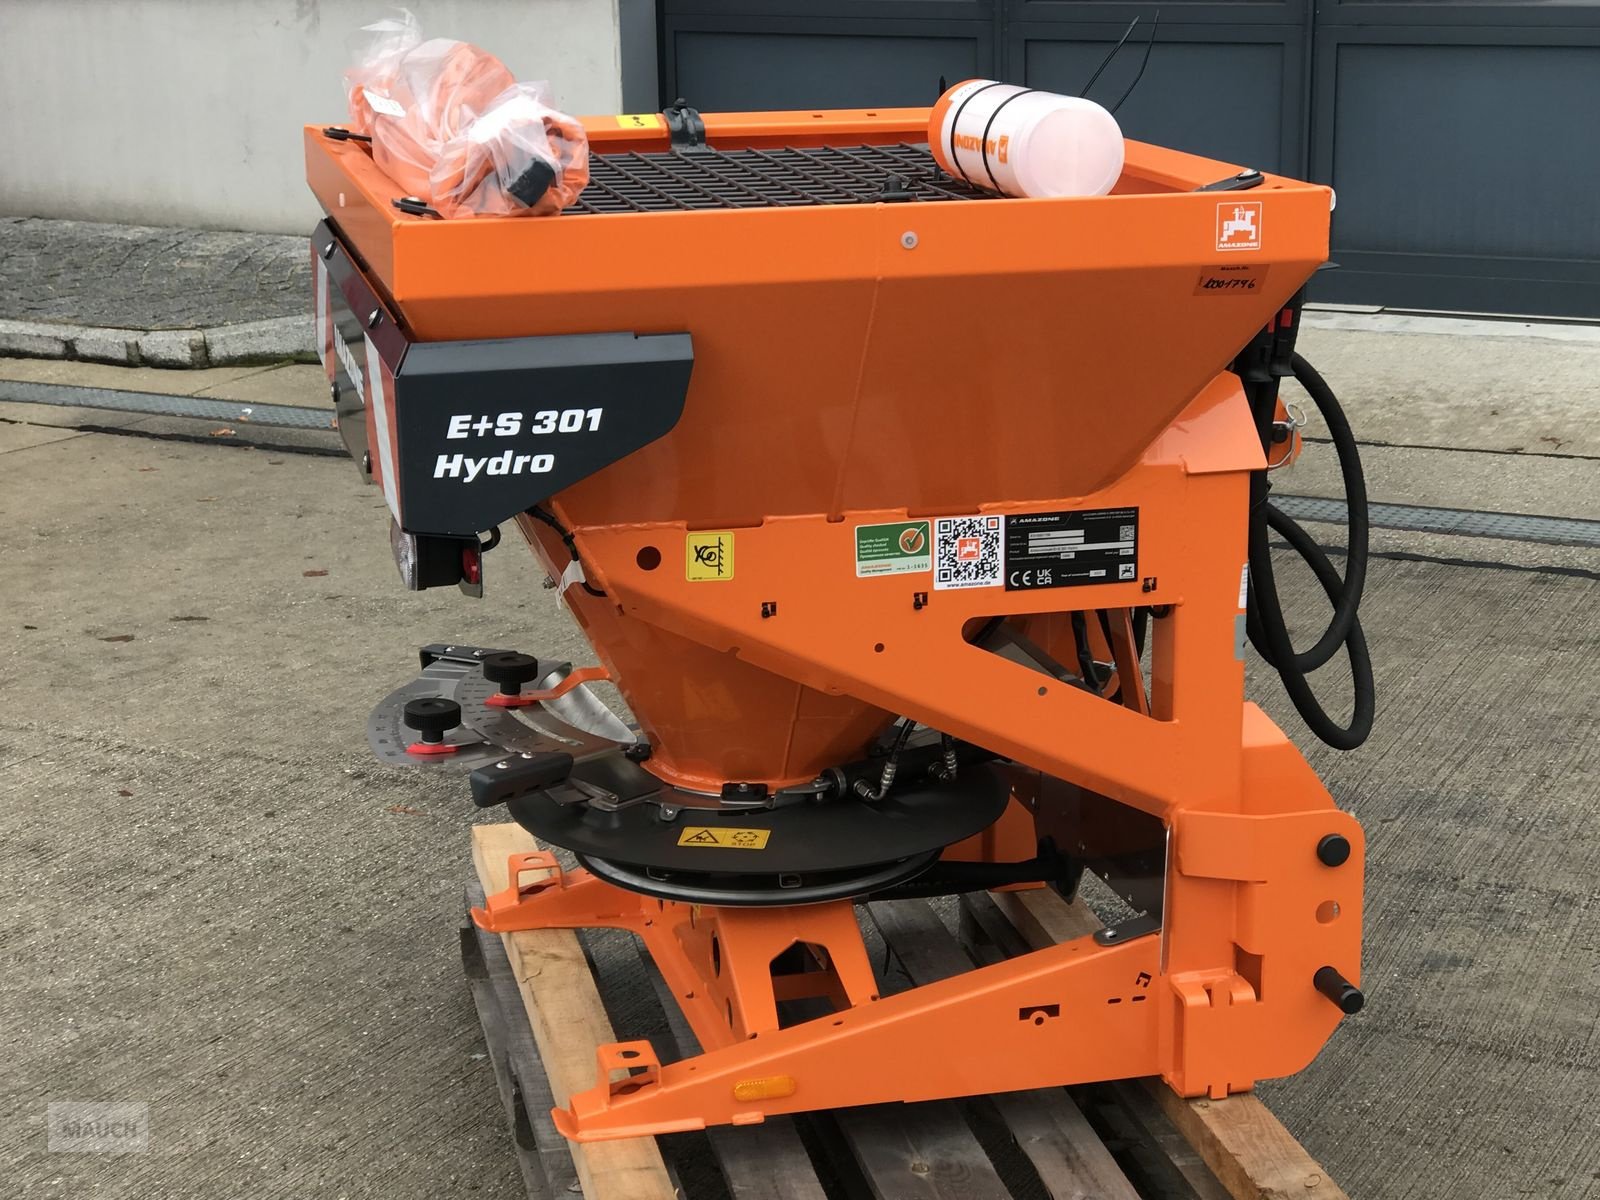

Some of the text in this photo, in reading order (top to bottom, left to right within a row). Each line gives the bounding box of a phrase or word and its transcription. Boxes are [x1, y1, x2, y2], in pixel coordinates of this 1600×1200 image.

[1218, 241, 1258, 249] AMAZONE
[446, 407, 603, 440] E+S 301
[433, 450, 555, 483] Hydro
[1018, 516, 1060, 524] AMAZONE
[1037, 568, 1052, 577] UK
[1010, 570, 1032, 587] CE
[1037, 577, 1052, 585] CA
